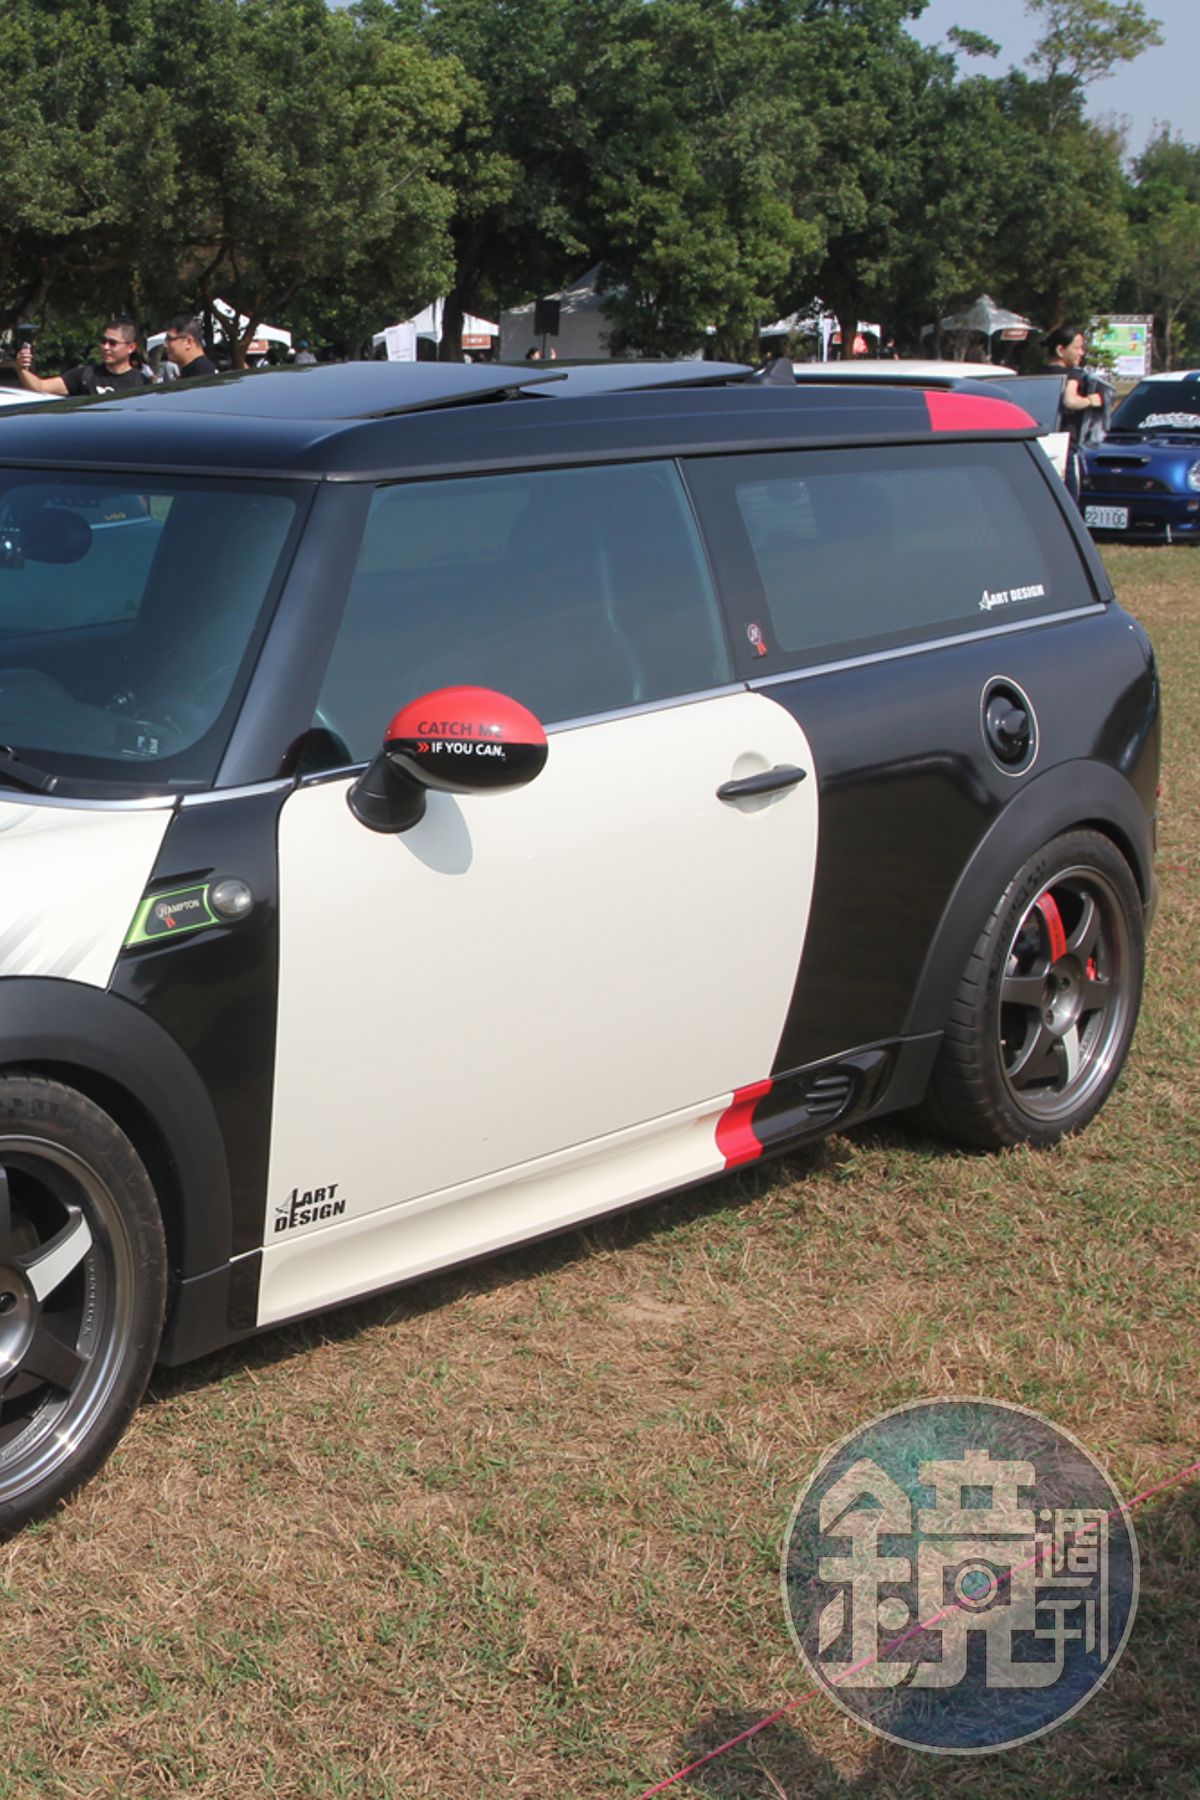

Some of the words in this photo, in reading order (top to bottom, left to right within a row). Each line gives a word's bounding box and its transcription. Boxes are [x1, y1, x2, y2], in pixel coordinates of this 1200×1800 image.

[417, 721, 472, 736] CATCH
[431, 742, 445, 753] IF
[445, 742, 472, 755] YOU
[274, 1199, 346, 1233] DESIGN
